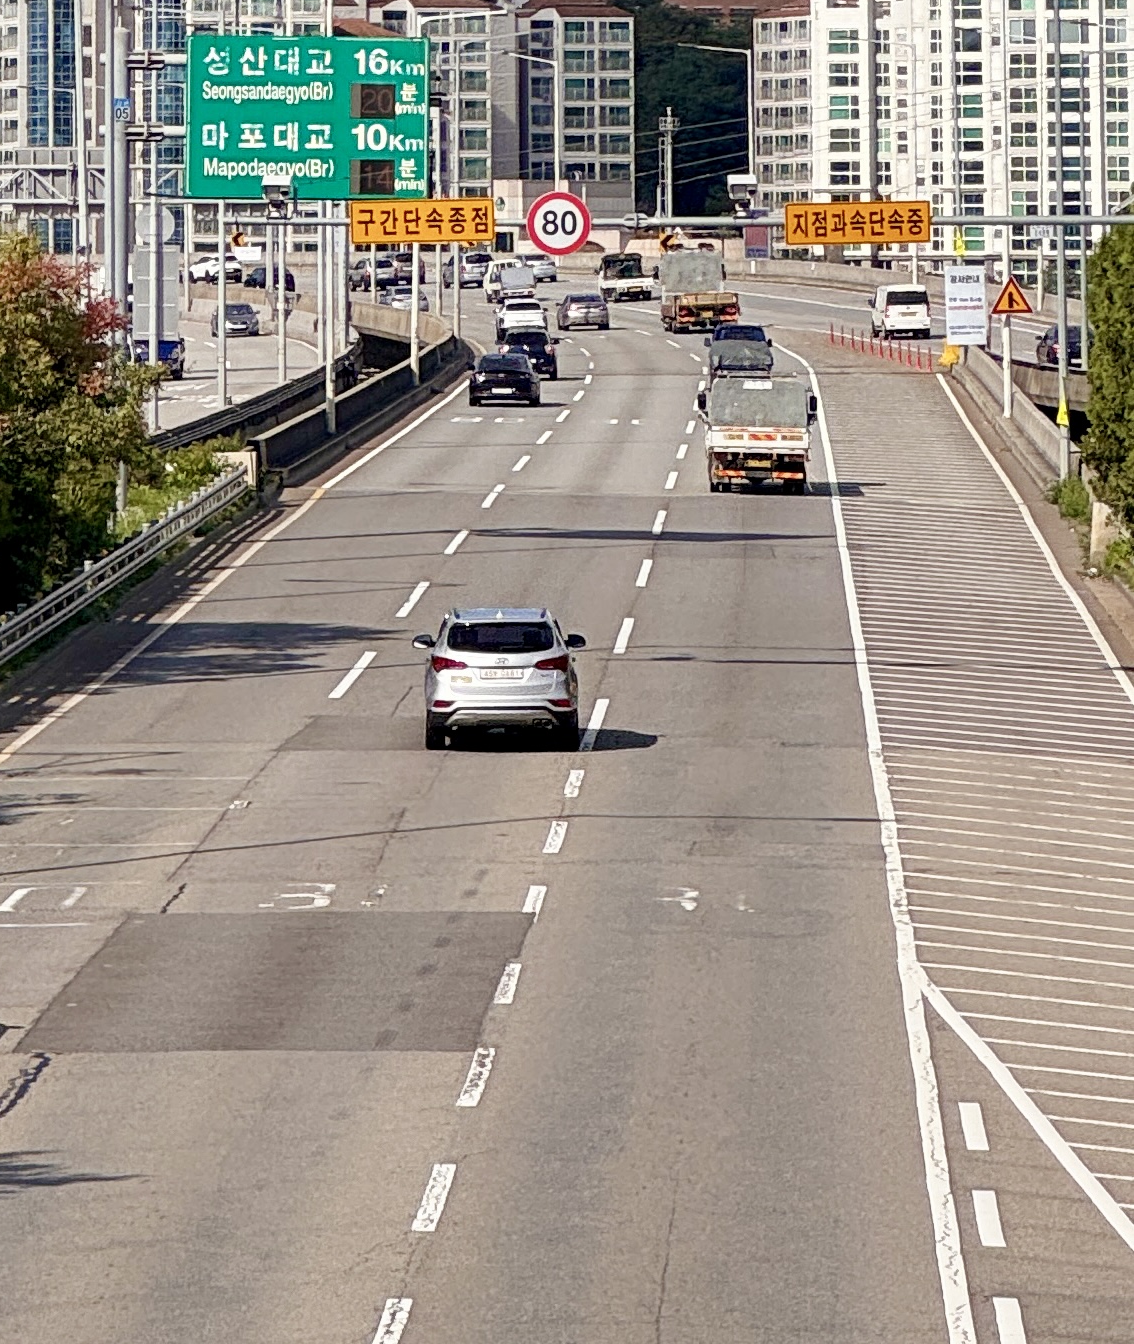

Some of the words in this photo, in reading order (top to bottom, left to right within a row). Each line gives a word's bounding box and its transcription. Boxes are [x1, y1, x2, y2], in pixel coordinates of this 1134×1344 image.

[202, 46, 335, 76] 성산대교
[202, 80, 334, 104] Seongsandaegyo(Br)
[400, 82, 418, 102] 분
[115, 107, 129, 120] 05
[394, 101, 426, 115] (min)
[201, 121, 334, 151] 마포대교
[399, 158, 417, 178] 분
[394, 177, 425, 192] (min)
[357, 206, 489, 236] 구간단속종점
[541, 209, 577, 236] 80
[792, 208, 924, 238] 지점과속단속중
